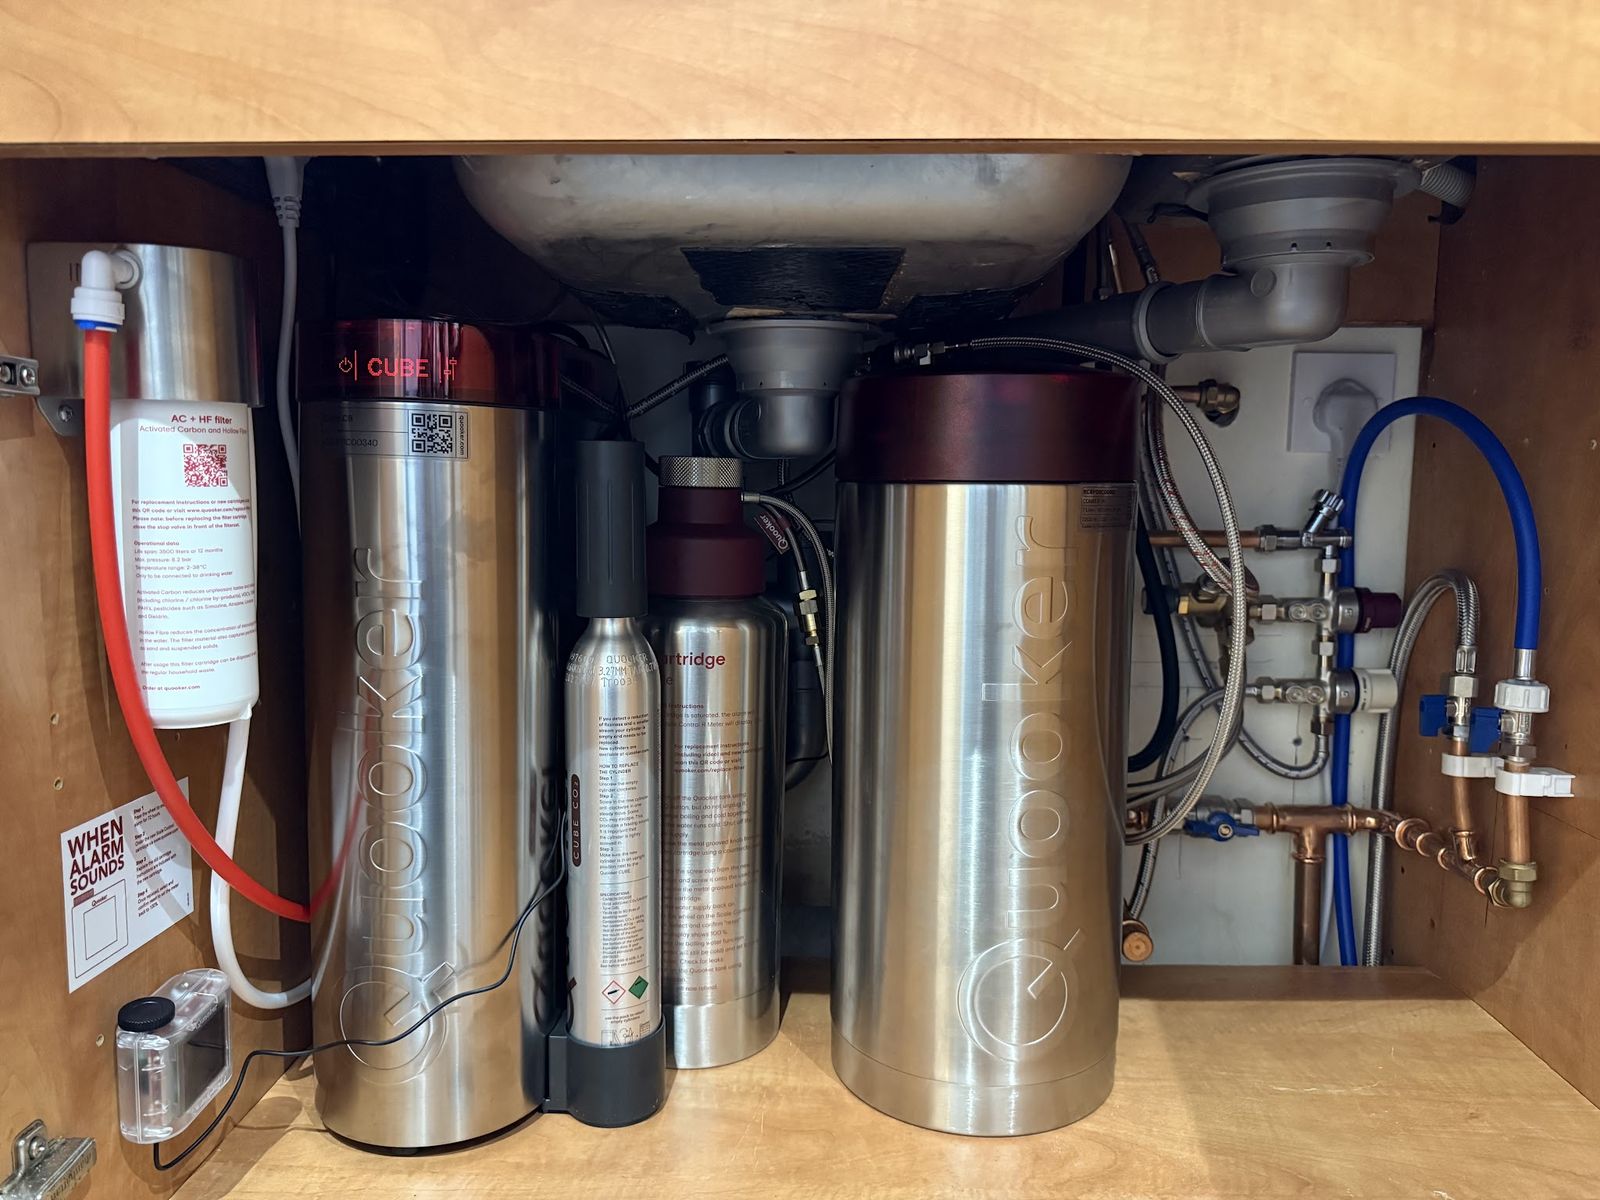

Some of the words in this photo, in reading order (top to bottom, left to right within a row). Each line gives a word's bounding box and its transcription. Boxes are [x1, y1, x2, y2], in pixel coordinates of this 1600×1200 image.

[368, 357, 428, 377] CUBE
[140, 425, 175, 433] Activated
[177, 426, 206, 434] Carbon
[171, 415, 187, 423] AC
[199, 416, 212, 424] HF
[214, 416, 232, 424] filter
[760, 514, 789, 550] Quooker
[661, 652, 726, 670] artridge
[957, 515, 1084, 1062] Quooker
[67, 815, 123, 859] WHEN
[705, 840, 729, 848] grooved
[69, 836, 125, 880] ALARM
[71, 854, 125, 896] SOUNDS
